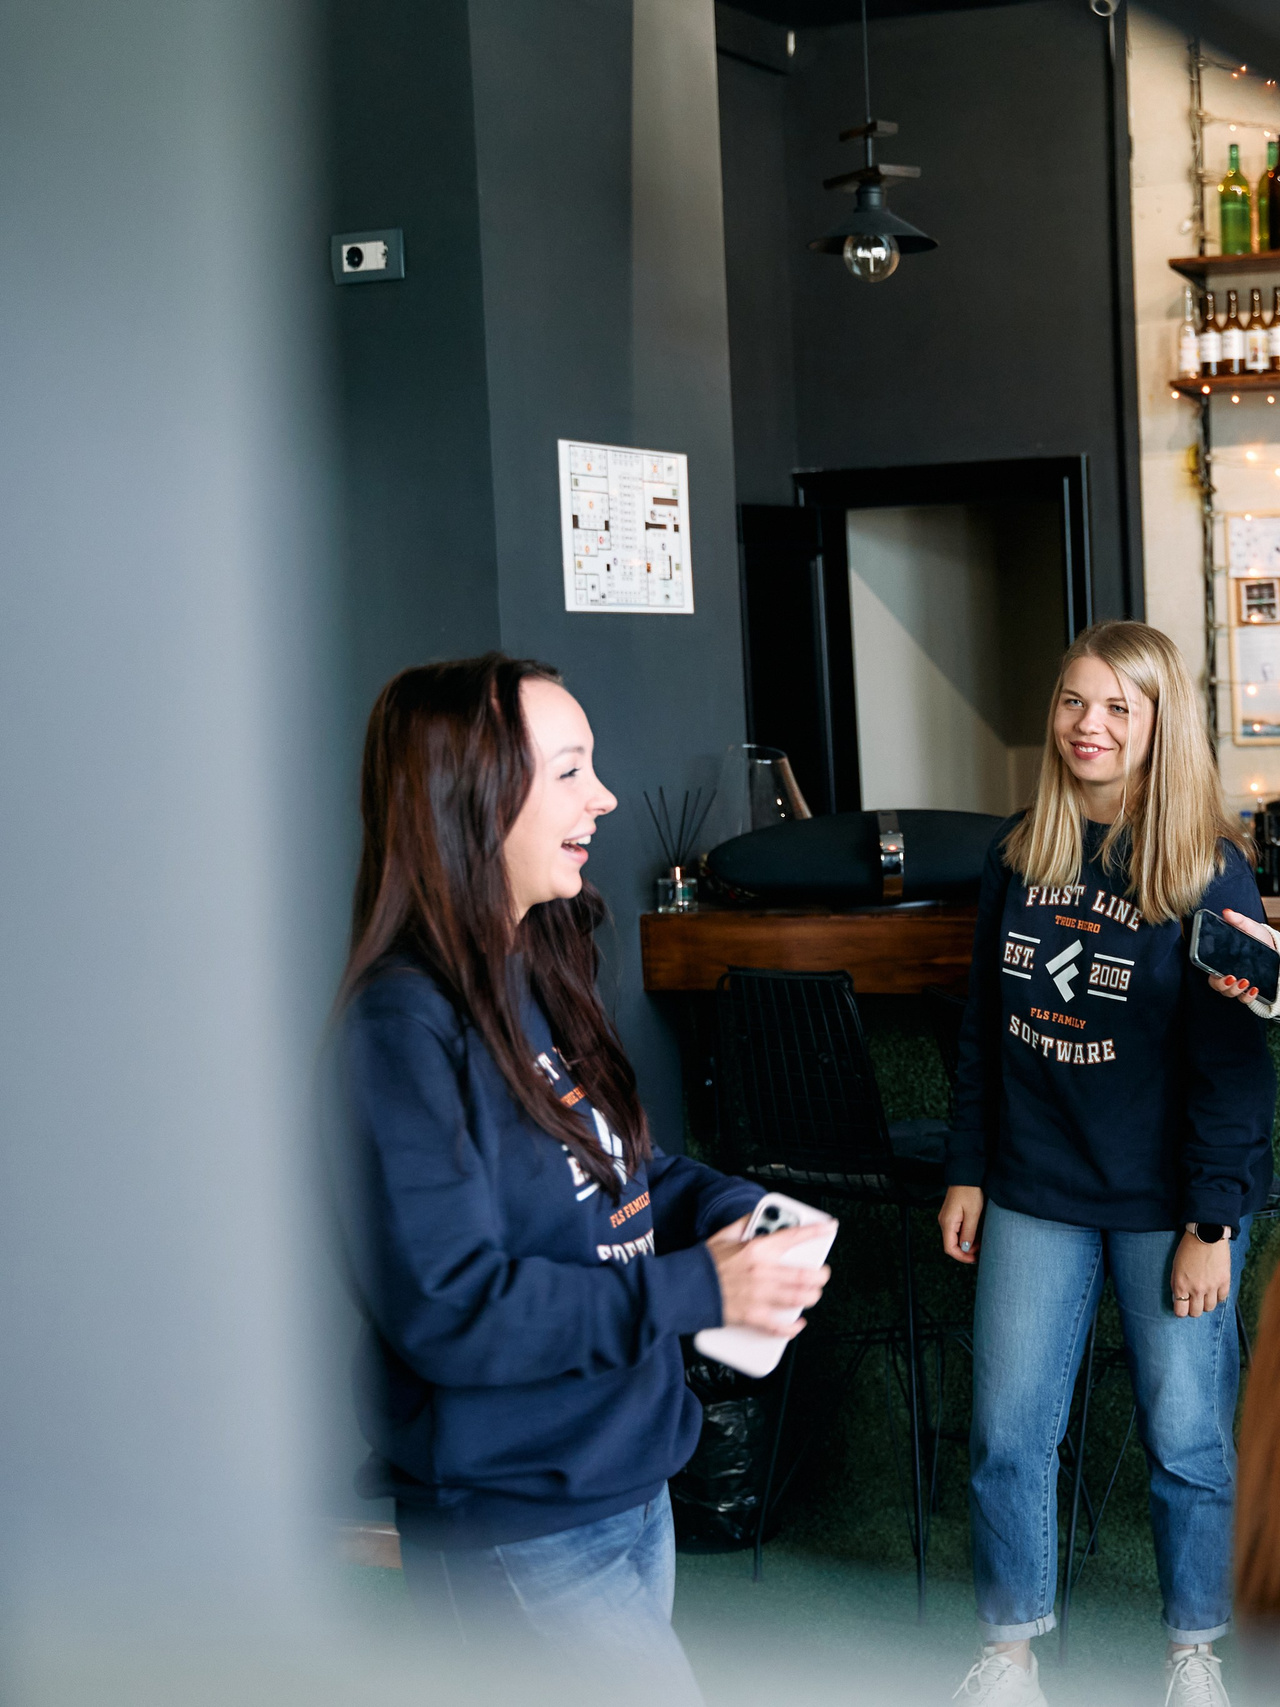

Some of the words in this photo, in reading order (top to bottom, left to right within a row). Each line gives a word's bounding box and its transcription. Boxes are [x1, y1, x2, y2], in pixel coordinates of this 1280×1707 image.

[1025, 884, 1087, 907] FIRST
[1092, 889, 1143, 932] LINE
[1055, 915, 1076, 927] TRUE
[1077, 919, 1101, 934] HERO
[1003, 941, 1035, 969] EST.
[1089, 962, 1131, 991] 2009
[1030, 1007, 1050, 1021] FLS
[1052, 1012, 1086, 1029] FAMILY
[1009, 1015, 1116, 1064] SOFTWARE
[609, 1207, 626, 1229] FLS
